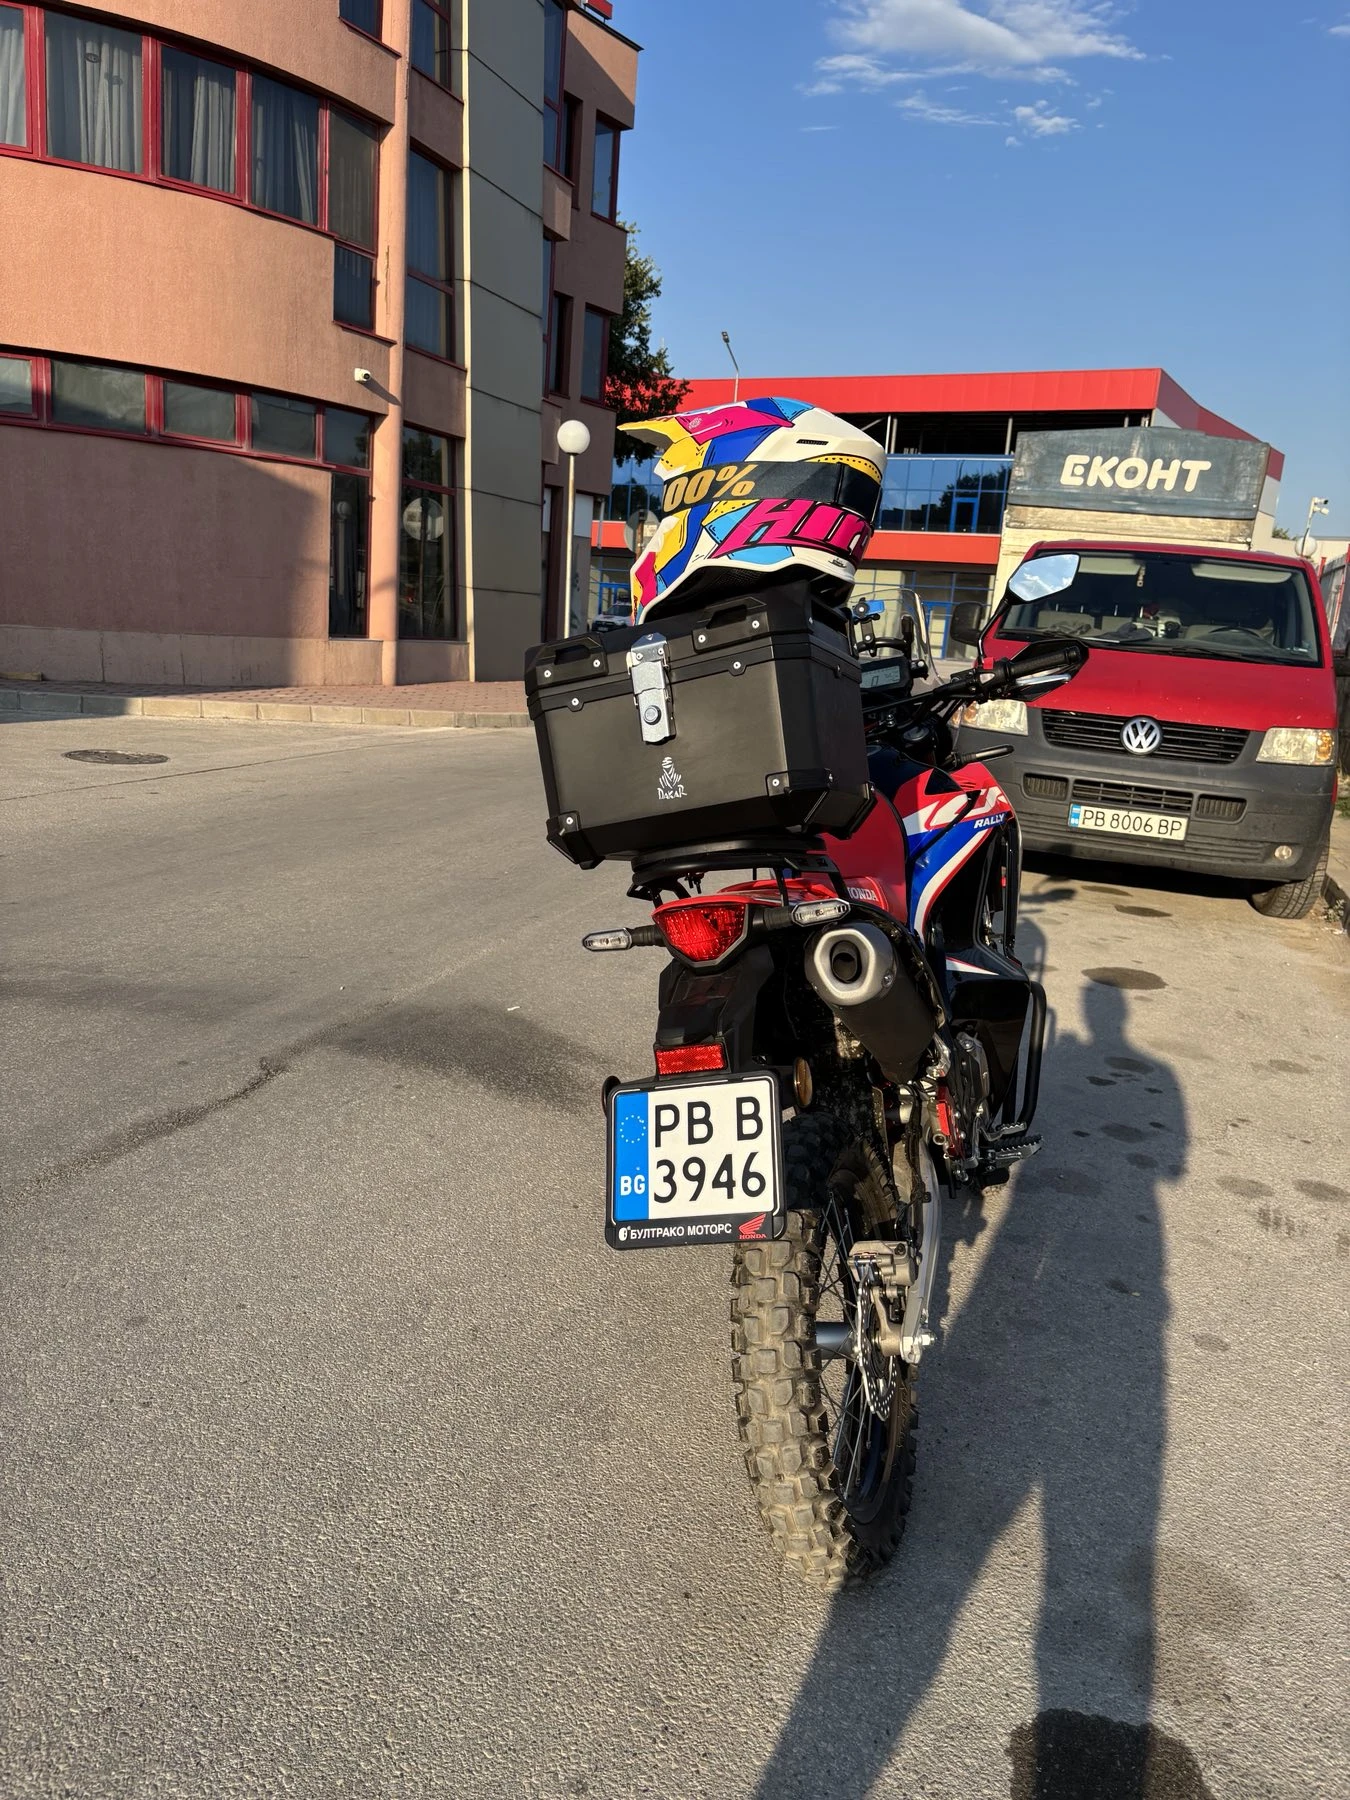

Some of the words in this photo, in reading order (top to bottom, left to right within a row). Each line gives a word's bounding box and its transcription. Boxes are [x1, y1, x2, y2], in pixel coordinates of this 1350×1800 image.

[661, 463, 759, 513] 00%
[973, 813, 1005, 829] RALLY
[1082, 809, 1106, 827] PB
[1109, 812, 1154, 833] 8006
[1157, 818, 1183, 837] BP
[654, 1100, 714, 1148] PB
[735, 1095, 764, 1141] B
[620, 1174, 646, 1196] BG
[653, 1151, 766, 1204] 3946
[629, 1225, 685, 1240] БУЛТРАКО
[687, 1222, 732, 1237] МОТОРС
